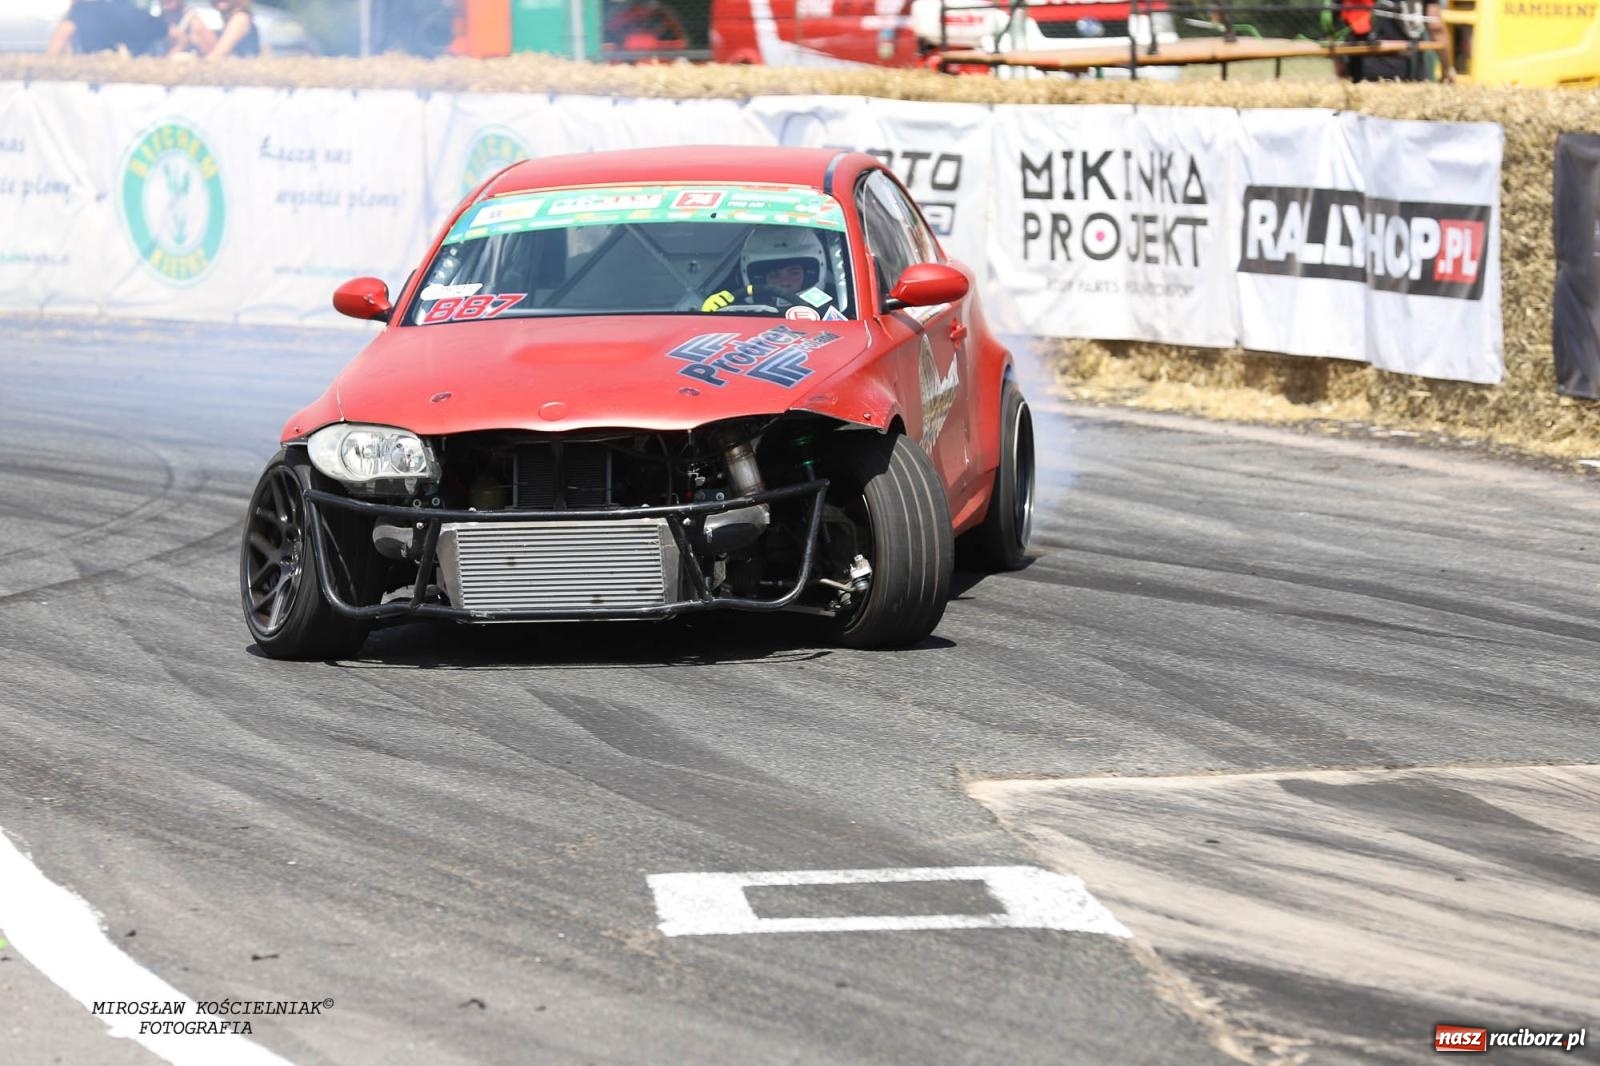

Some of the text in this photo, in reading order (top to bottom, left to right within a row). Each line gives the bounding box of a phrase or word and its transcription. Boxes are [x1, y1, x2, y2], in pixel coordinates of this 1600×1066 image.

[1020, 149, 1208, 205] MIKINKA
[1022, 212, 1208, 268] PROJEKT
[424, 293, 528, 323] 887
[677, 324, 808, 388] Prodrex
